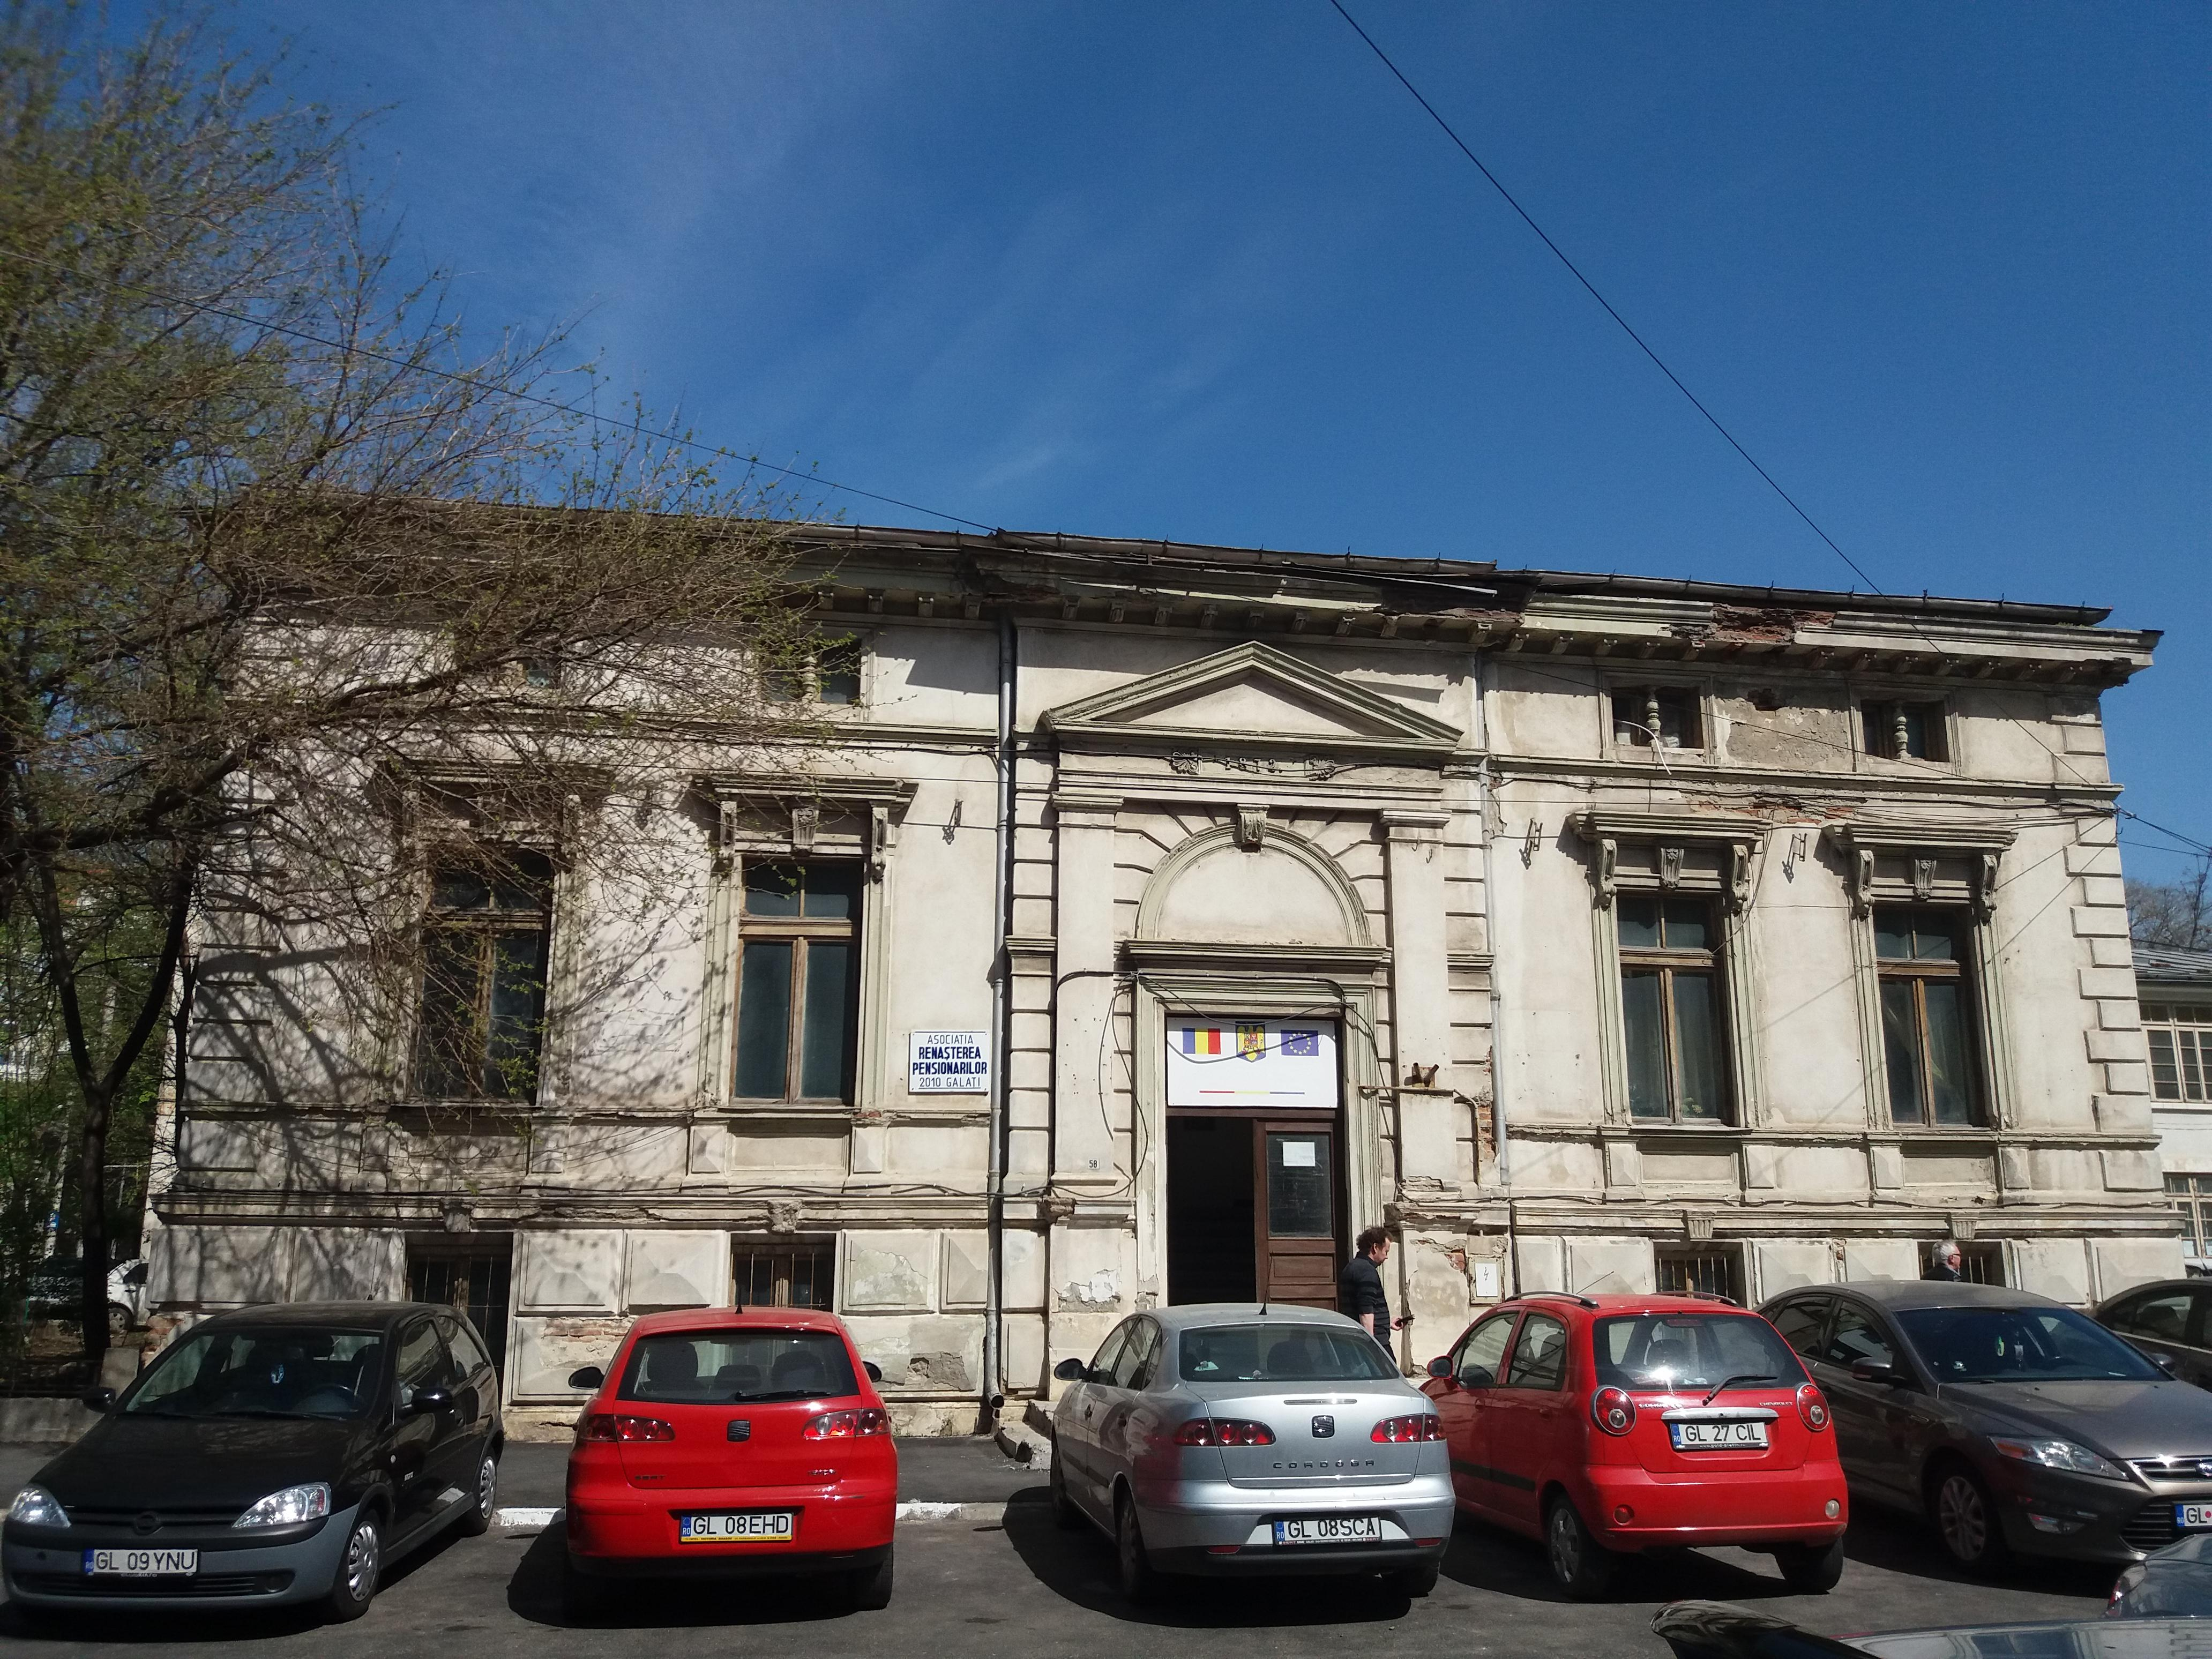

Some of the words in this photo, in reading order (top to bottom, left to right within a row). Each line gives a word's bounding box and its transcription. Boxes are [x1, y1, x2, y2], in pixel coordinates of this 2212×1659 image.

[913, 1062, 987, 1075] PENSIONARILOR
[920, 1077, 941, 1087] 2010
[1089, 1160, 1097, 1168] 58
[1685, 1425, 1707, 1442] GL
[1712, 1425, 1730, 1441] 27
[1736, 1424, 1761, 1441] CIL
[1273, 1459, 1375, 1469] CORDOBA
[2186, 1507, 2208, 1524] GL
[682, 1527, 691, 1535] RO
[693, 1516, 717, 1535] GL
[1276, 1531, 1284, 1540] RO
[1288, 1521, 1312, 1538] GL
[96, 1551, 119, 1571] GL
[128, 1552, 150, 1571] 09
[153, 1551, 196, 1571] YNU
